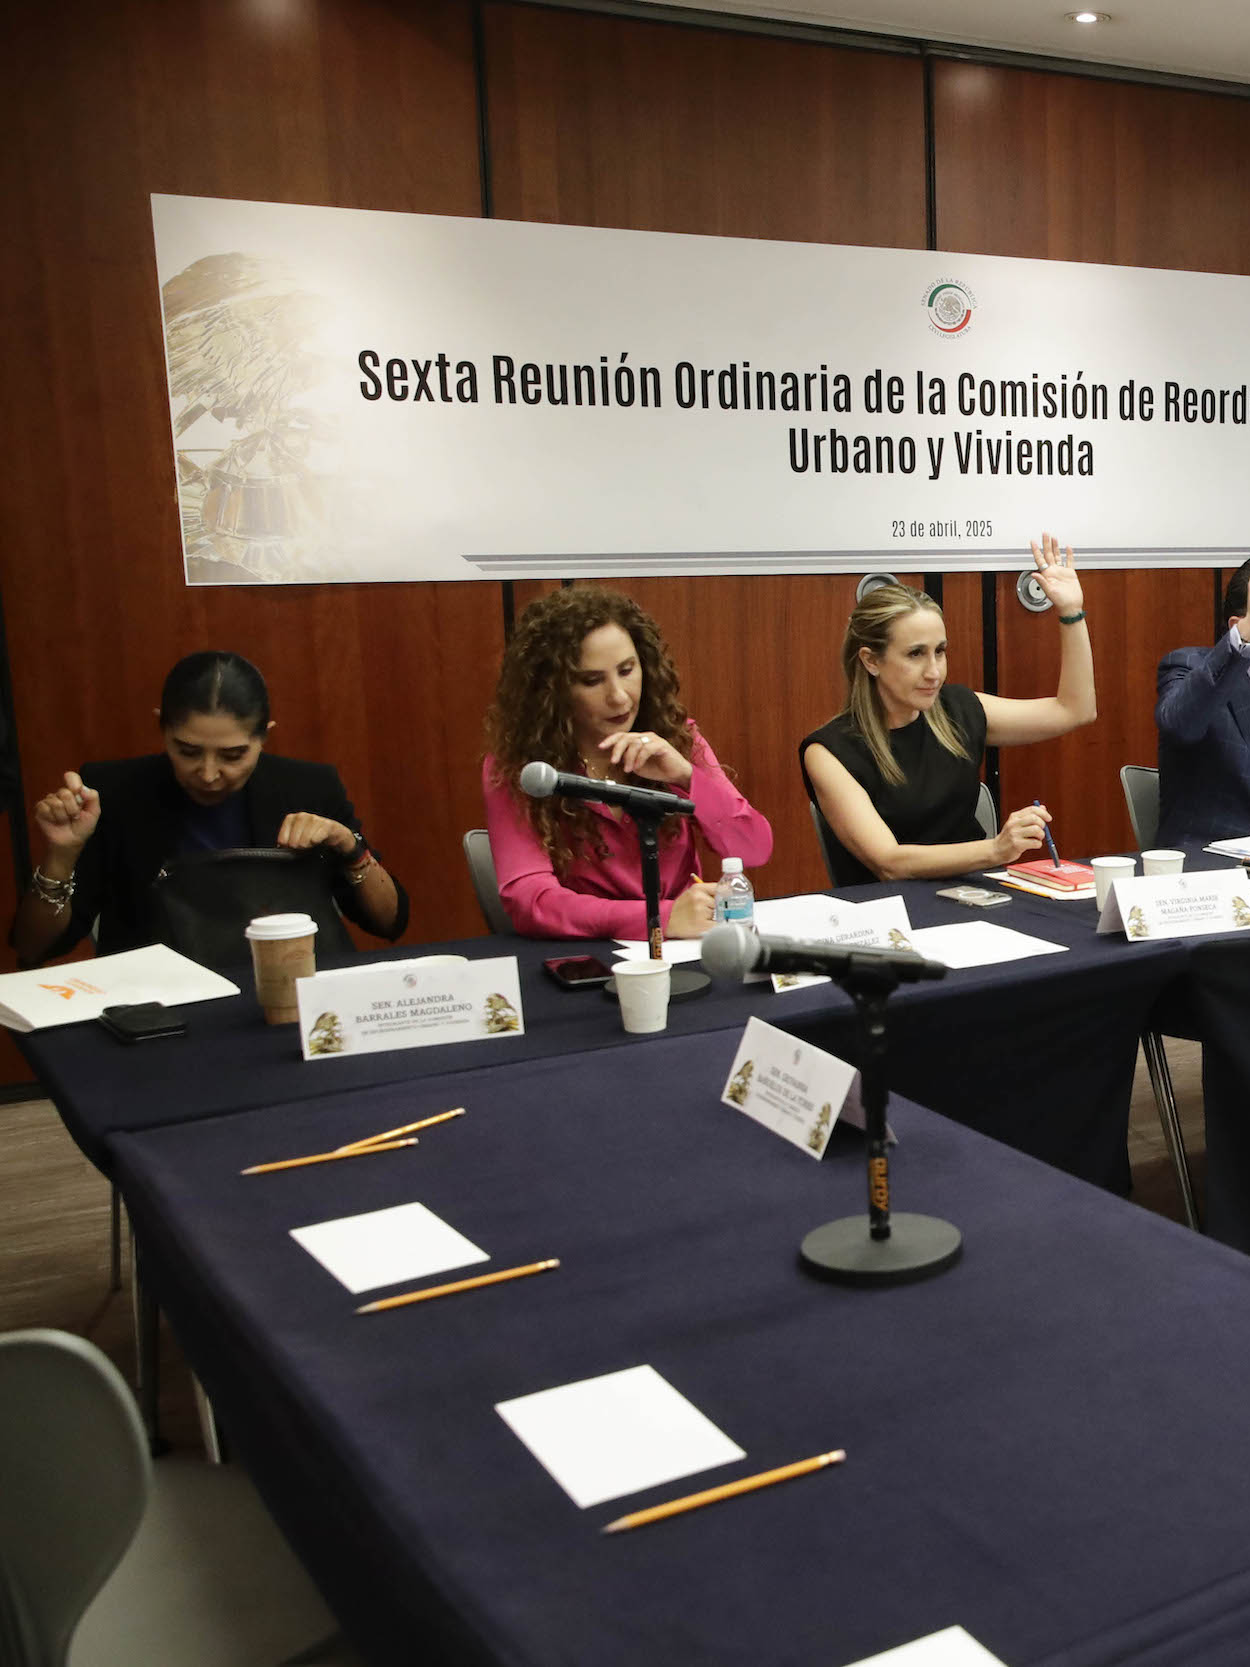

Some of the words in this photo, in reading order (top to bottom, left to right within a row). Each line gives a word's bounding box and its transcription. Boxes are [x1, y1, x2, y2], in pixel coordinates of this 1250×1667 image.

[358, 350, 479, 403] Sexta
[492, 352, 662, 408] Reunión
[675, 361, 852, 413] Ordinaria
[864, 368, 905, 414] de
[916, 370, 946, 415] la
[958, 370, 1108, 420] Comisión
[1119, 379, 1154, 422] de
[789, 427, 916, 474] Urbano
[927, 437, 944, 480] y
[954, 429, 1094, 476] Vivienda
[892, 520, 906, 538] 23
[910, 520, 925, 538] de
[929, 519, 961, 540] abril,
[966, 520, 993, 538] 2025
[396, 994, 455, 1008] ALEJANDRA
[355, 1010, 407, 1024] BARRALES
[410, 1002, 473, 1017] MAGDALENO
